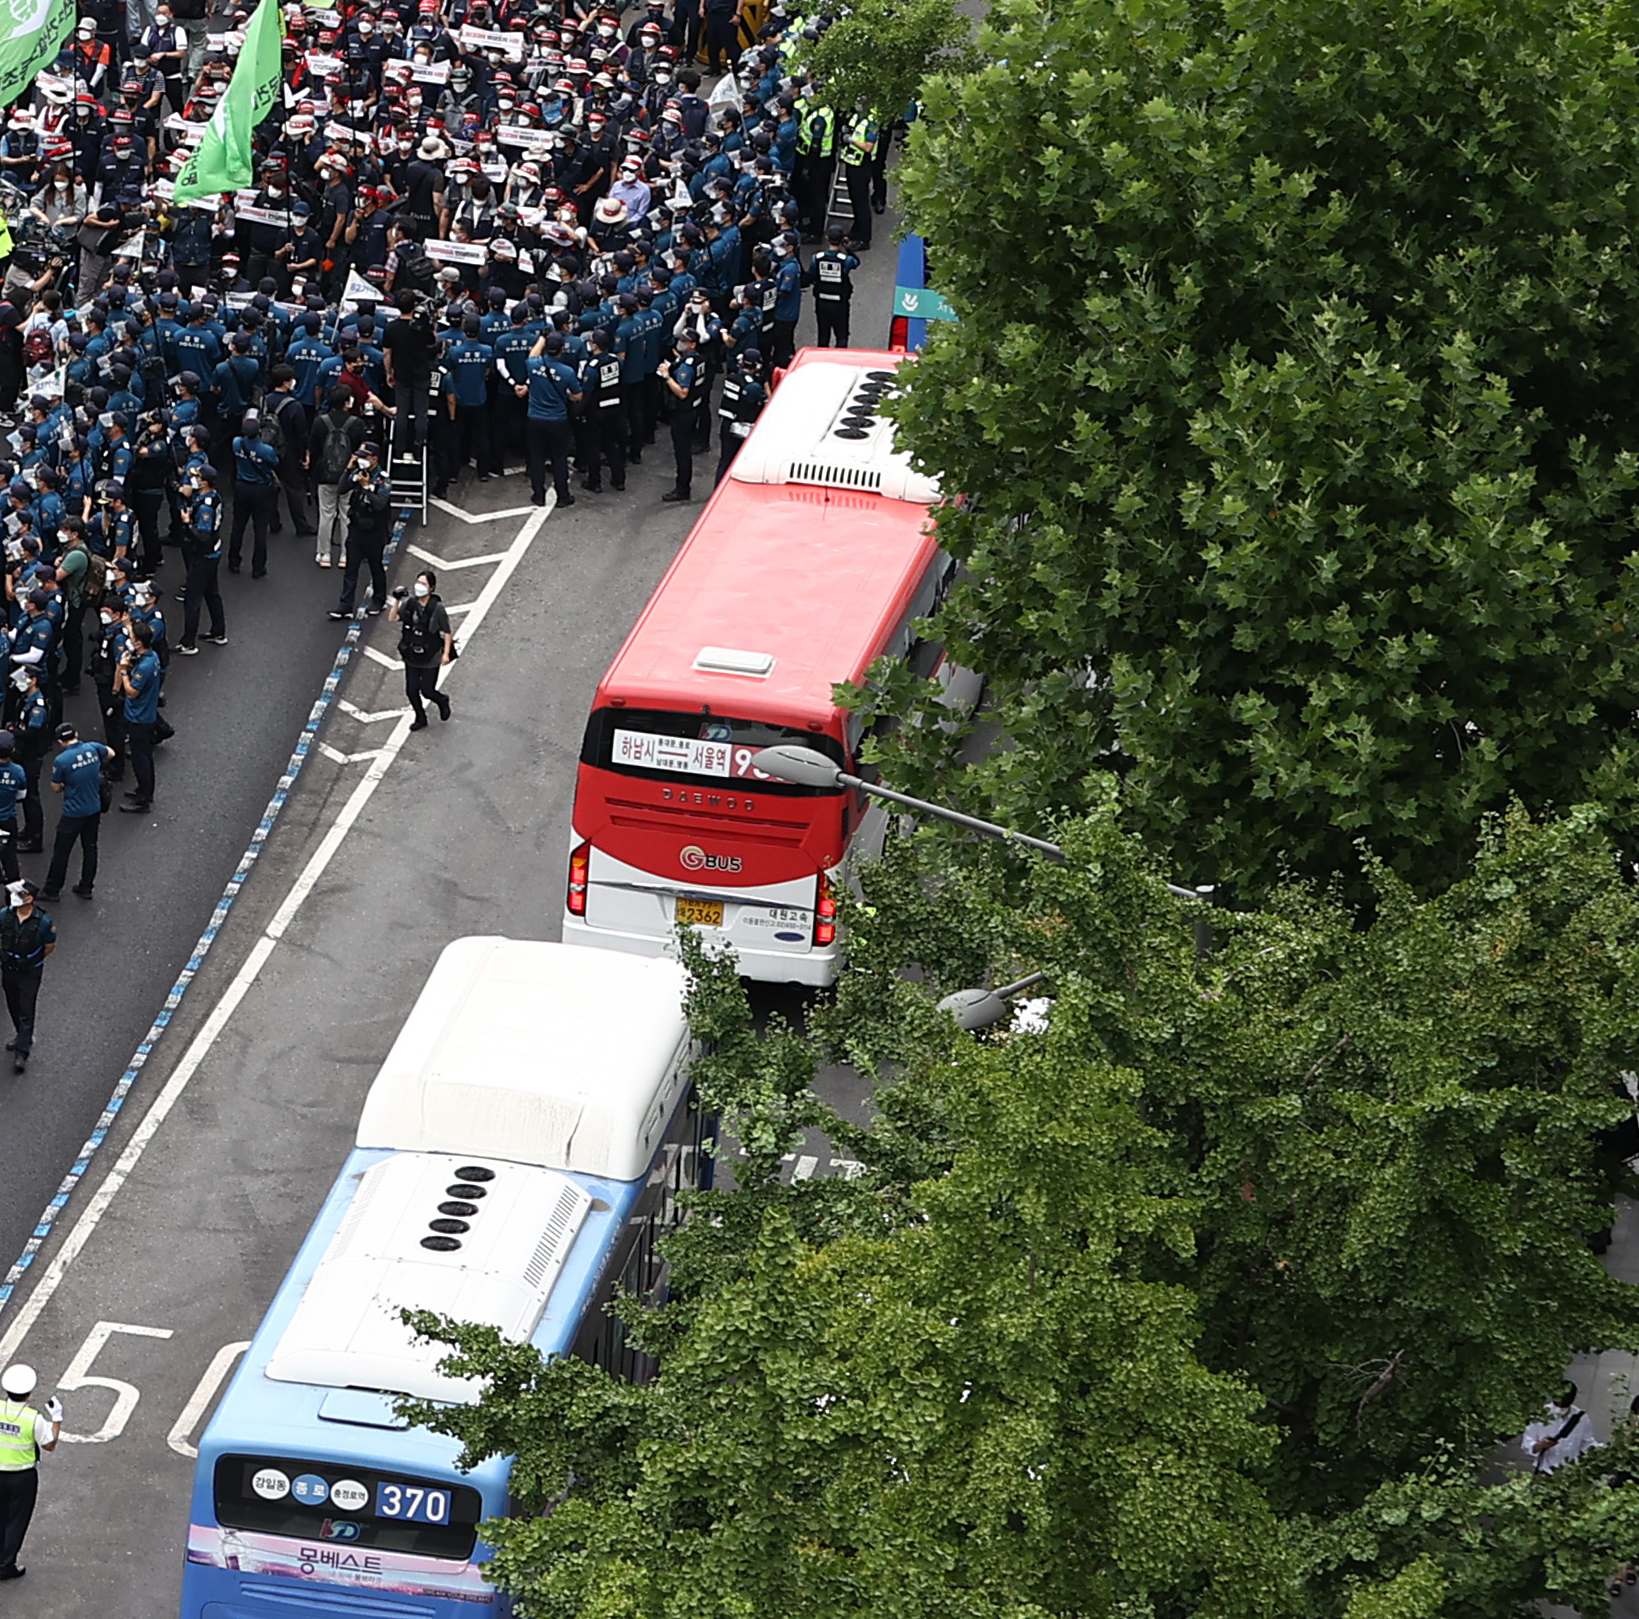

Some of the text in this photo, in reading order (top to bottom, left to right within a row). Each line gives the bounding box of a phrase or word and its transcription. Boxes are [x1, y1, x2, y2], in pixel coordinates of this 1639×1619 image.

[620, 735, 656, 762] 하남시
[692, 746, 728, 772] 서울역
[662, 788, 755, 811] DAEWOO
[687, 908, 721, 925] 2362
[769, 908, 808, 923] 대원고속
[255, 1476, 287, 1492] 강일동
[334, 1489, 366, 1502] 충정로역
[381, 1485, 446, 1522] 370
[297, 1547, 383, 1576] 몽베스트
